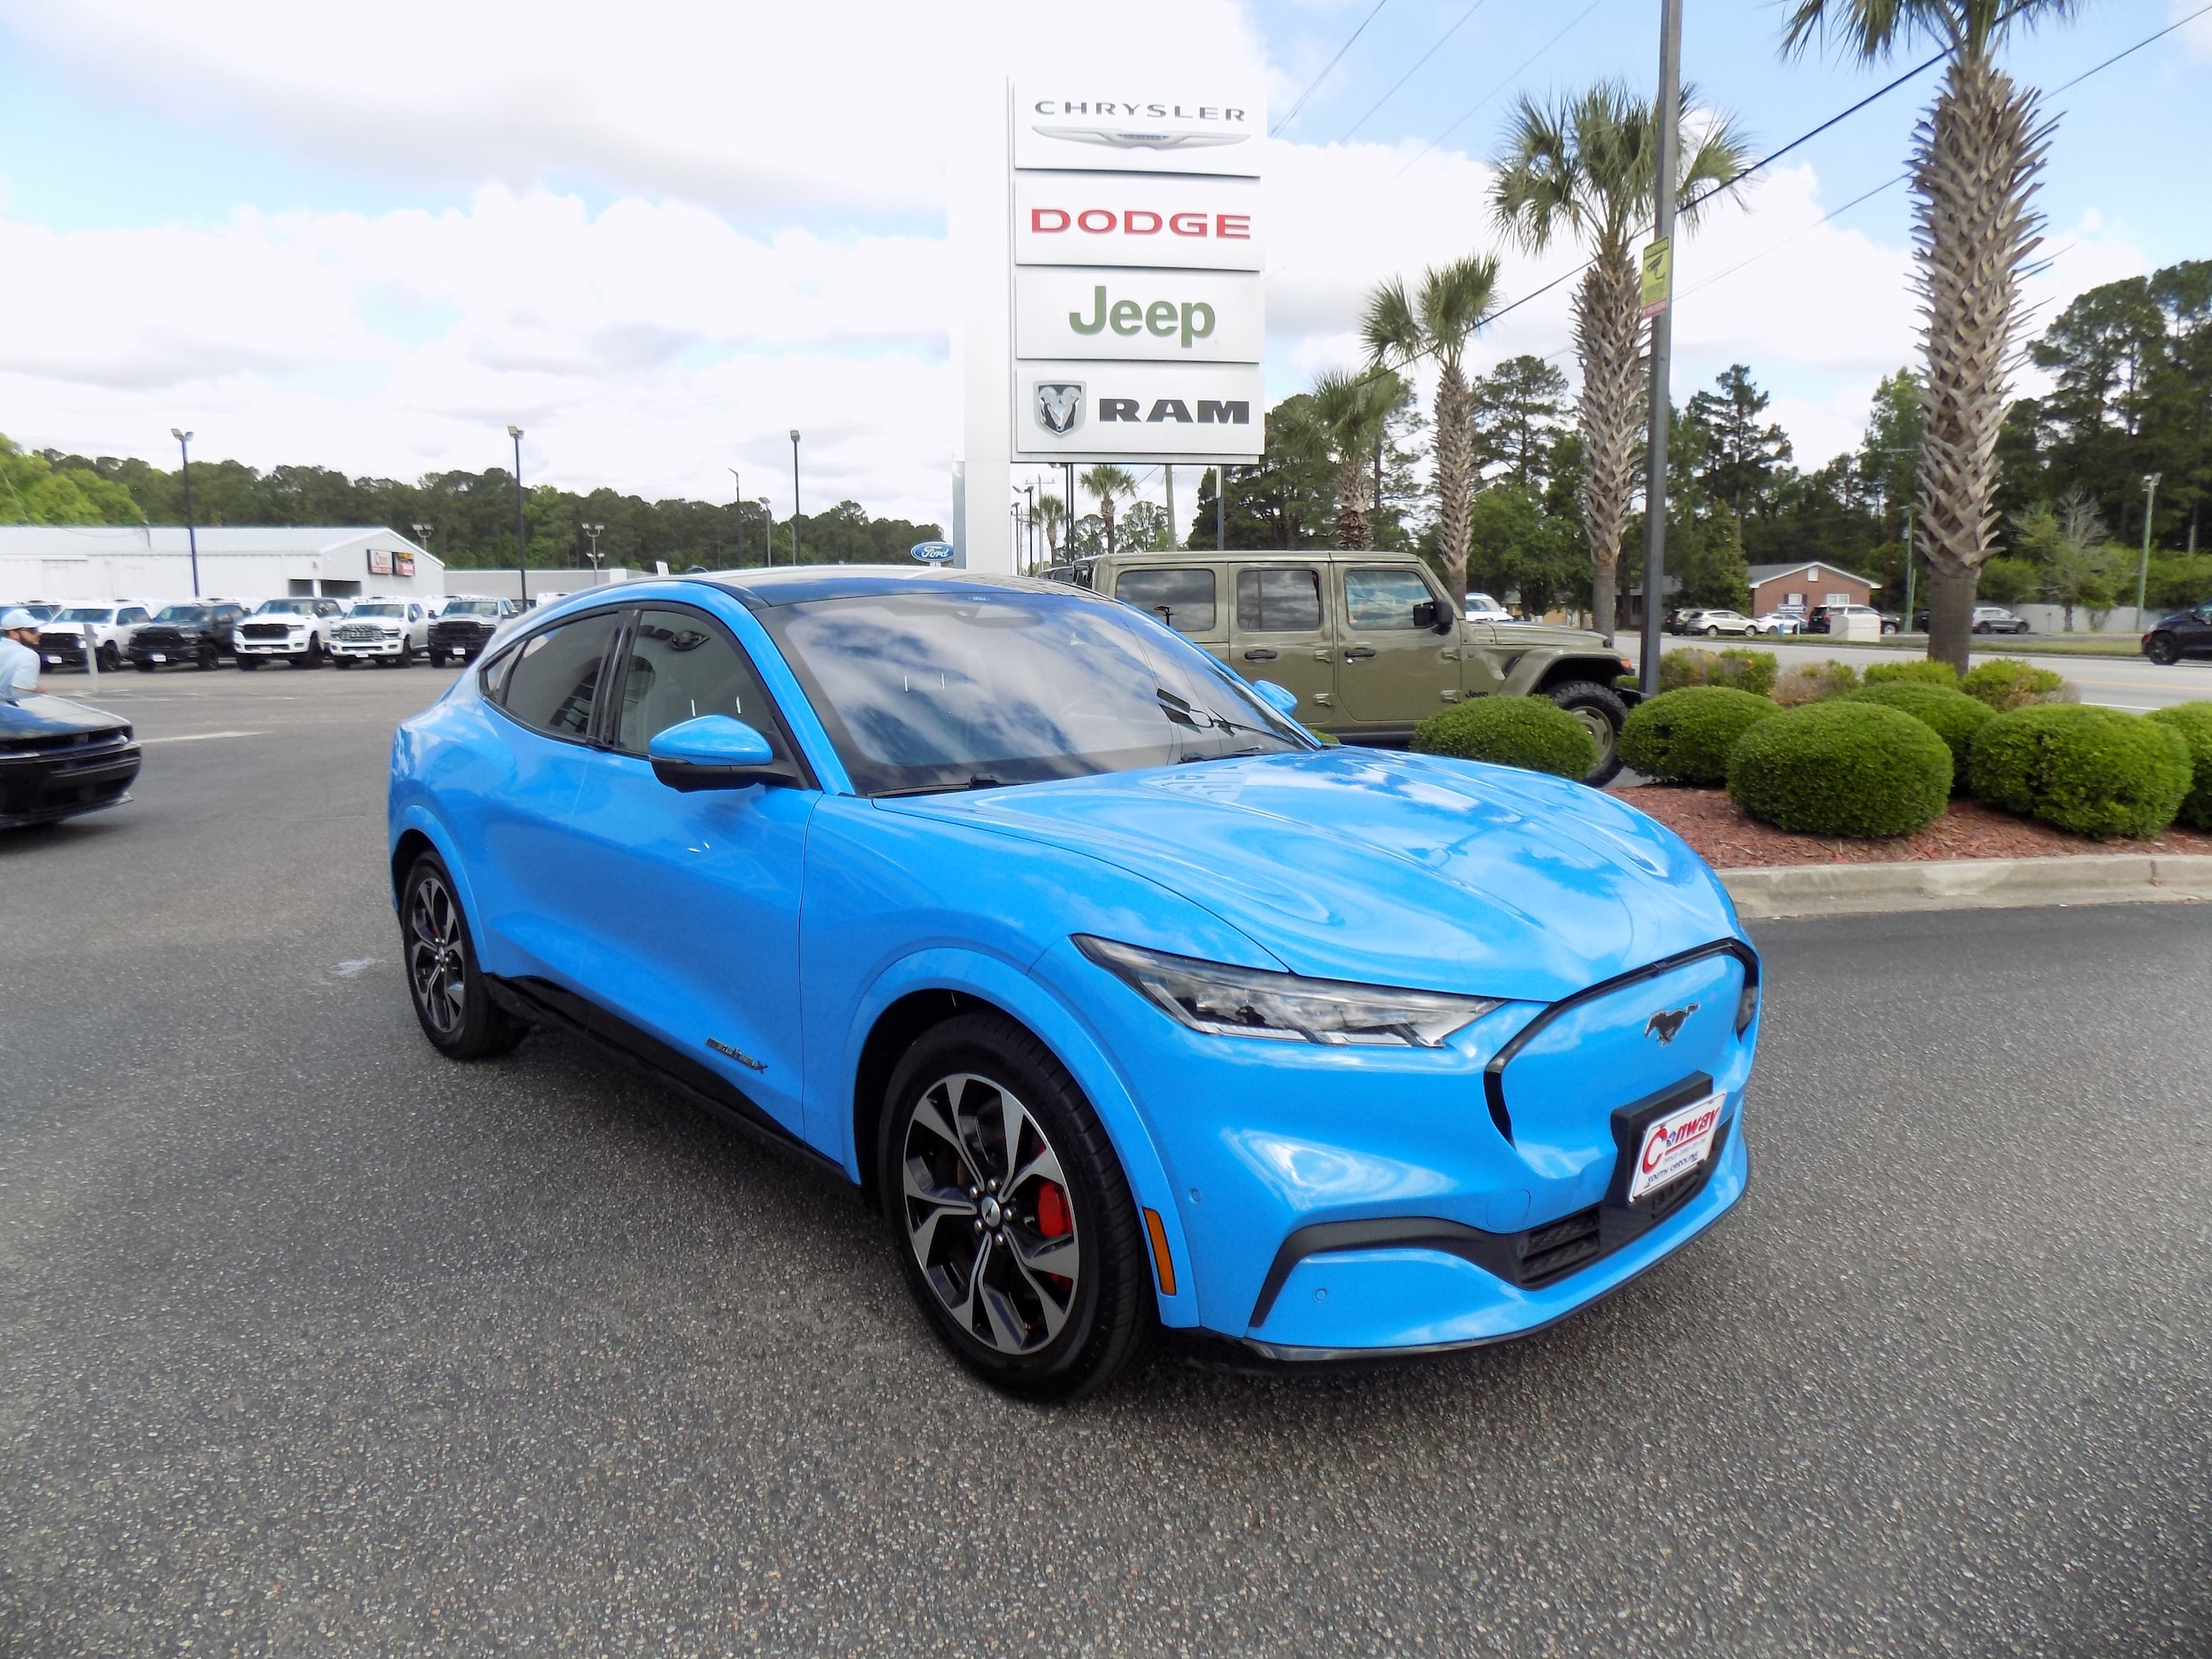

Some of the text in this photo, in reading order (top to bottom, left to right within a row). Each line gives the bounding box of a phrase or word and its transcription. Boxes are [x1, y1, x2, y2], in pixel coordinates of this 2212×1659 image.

[1034, 100, 1246, 122] CHRYSLER
[1031, 208, 1251, 240] DODGE
[1068, 285, 1216, 349] Jeep
[1099, 397, 1250, 425] RAM
[921, 545, 949, 558] Ford
